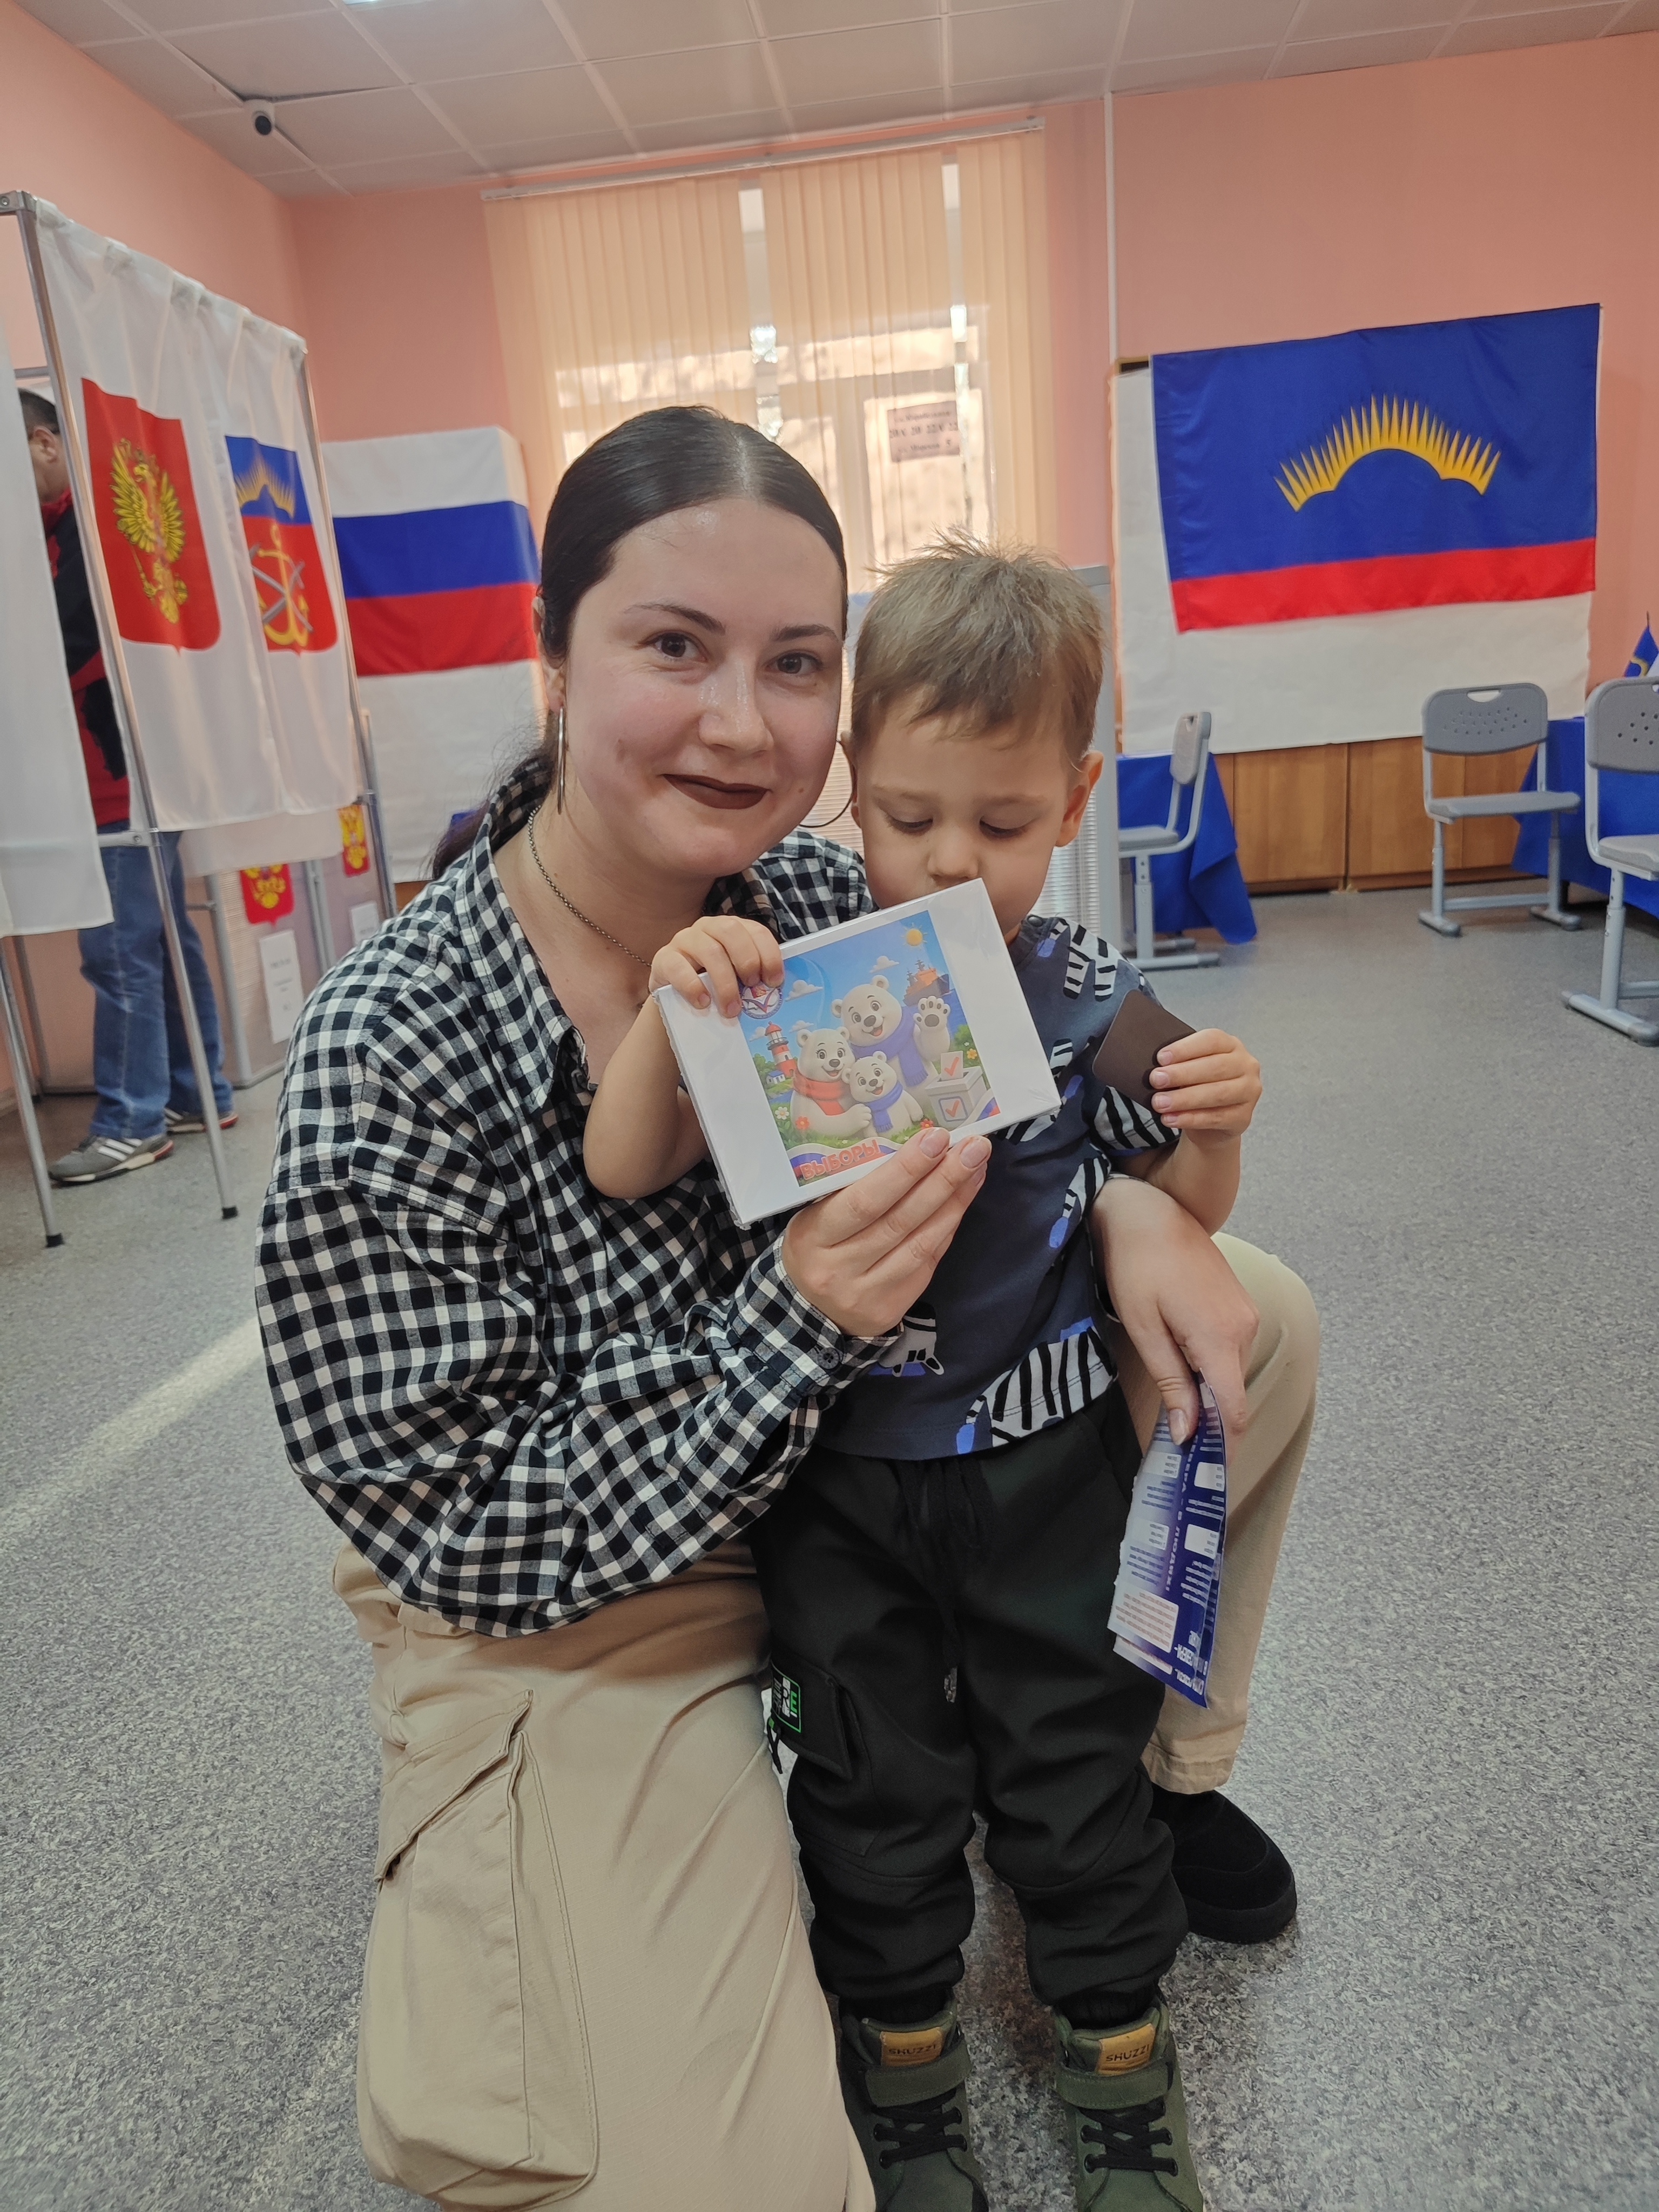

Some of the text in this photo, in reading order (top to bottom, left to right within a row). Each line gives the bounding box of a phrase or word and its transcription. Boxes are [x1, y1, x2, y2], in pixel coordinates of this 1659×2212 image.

[800, 1139, 881, 1180] ВЫБОРЫ
[888, 2044, 936, 2055] SHUZZI
[1105, 2044, 1150, 2061] SHUZZI
